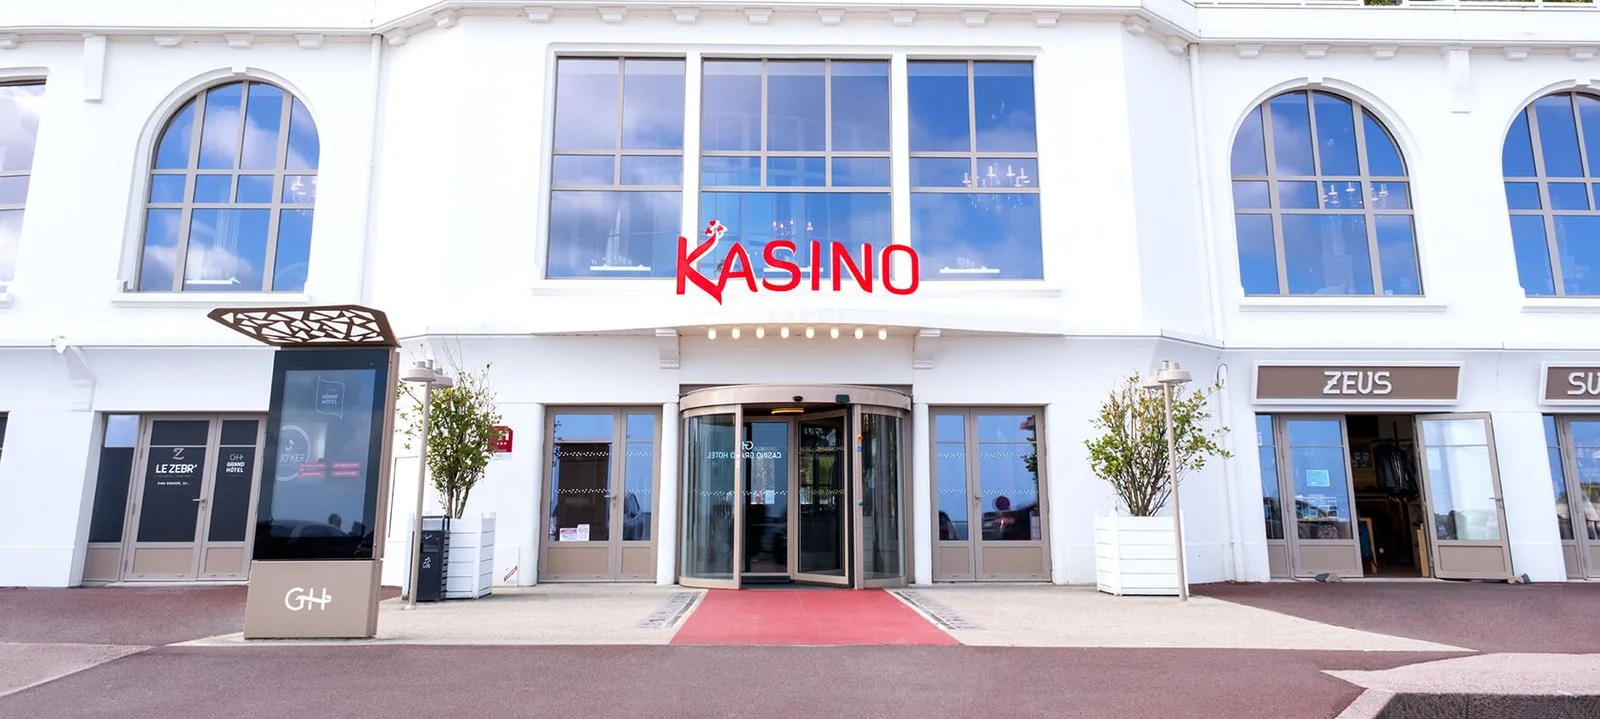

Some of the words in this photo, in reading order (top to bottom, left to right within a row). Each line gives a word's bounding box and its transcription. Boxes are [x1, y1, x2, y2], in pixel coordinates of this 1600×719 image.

[676, 225, 920, 305] KASINO
[1322, 371, 1393, 395] ZEUS
[1567, 372, 1600, 395] SU
[155, 464, 168, 474] LE
